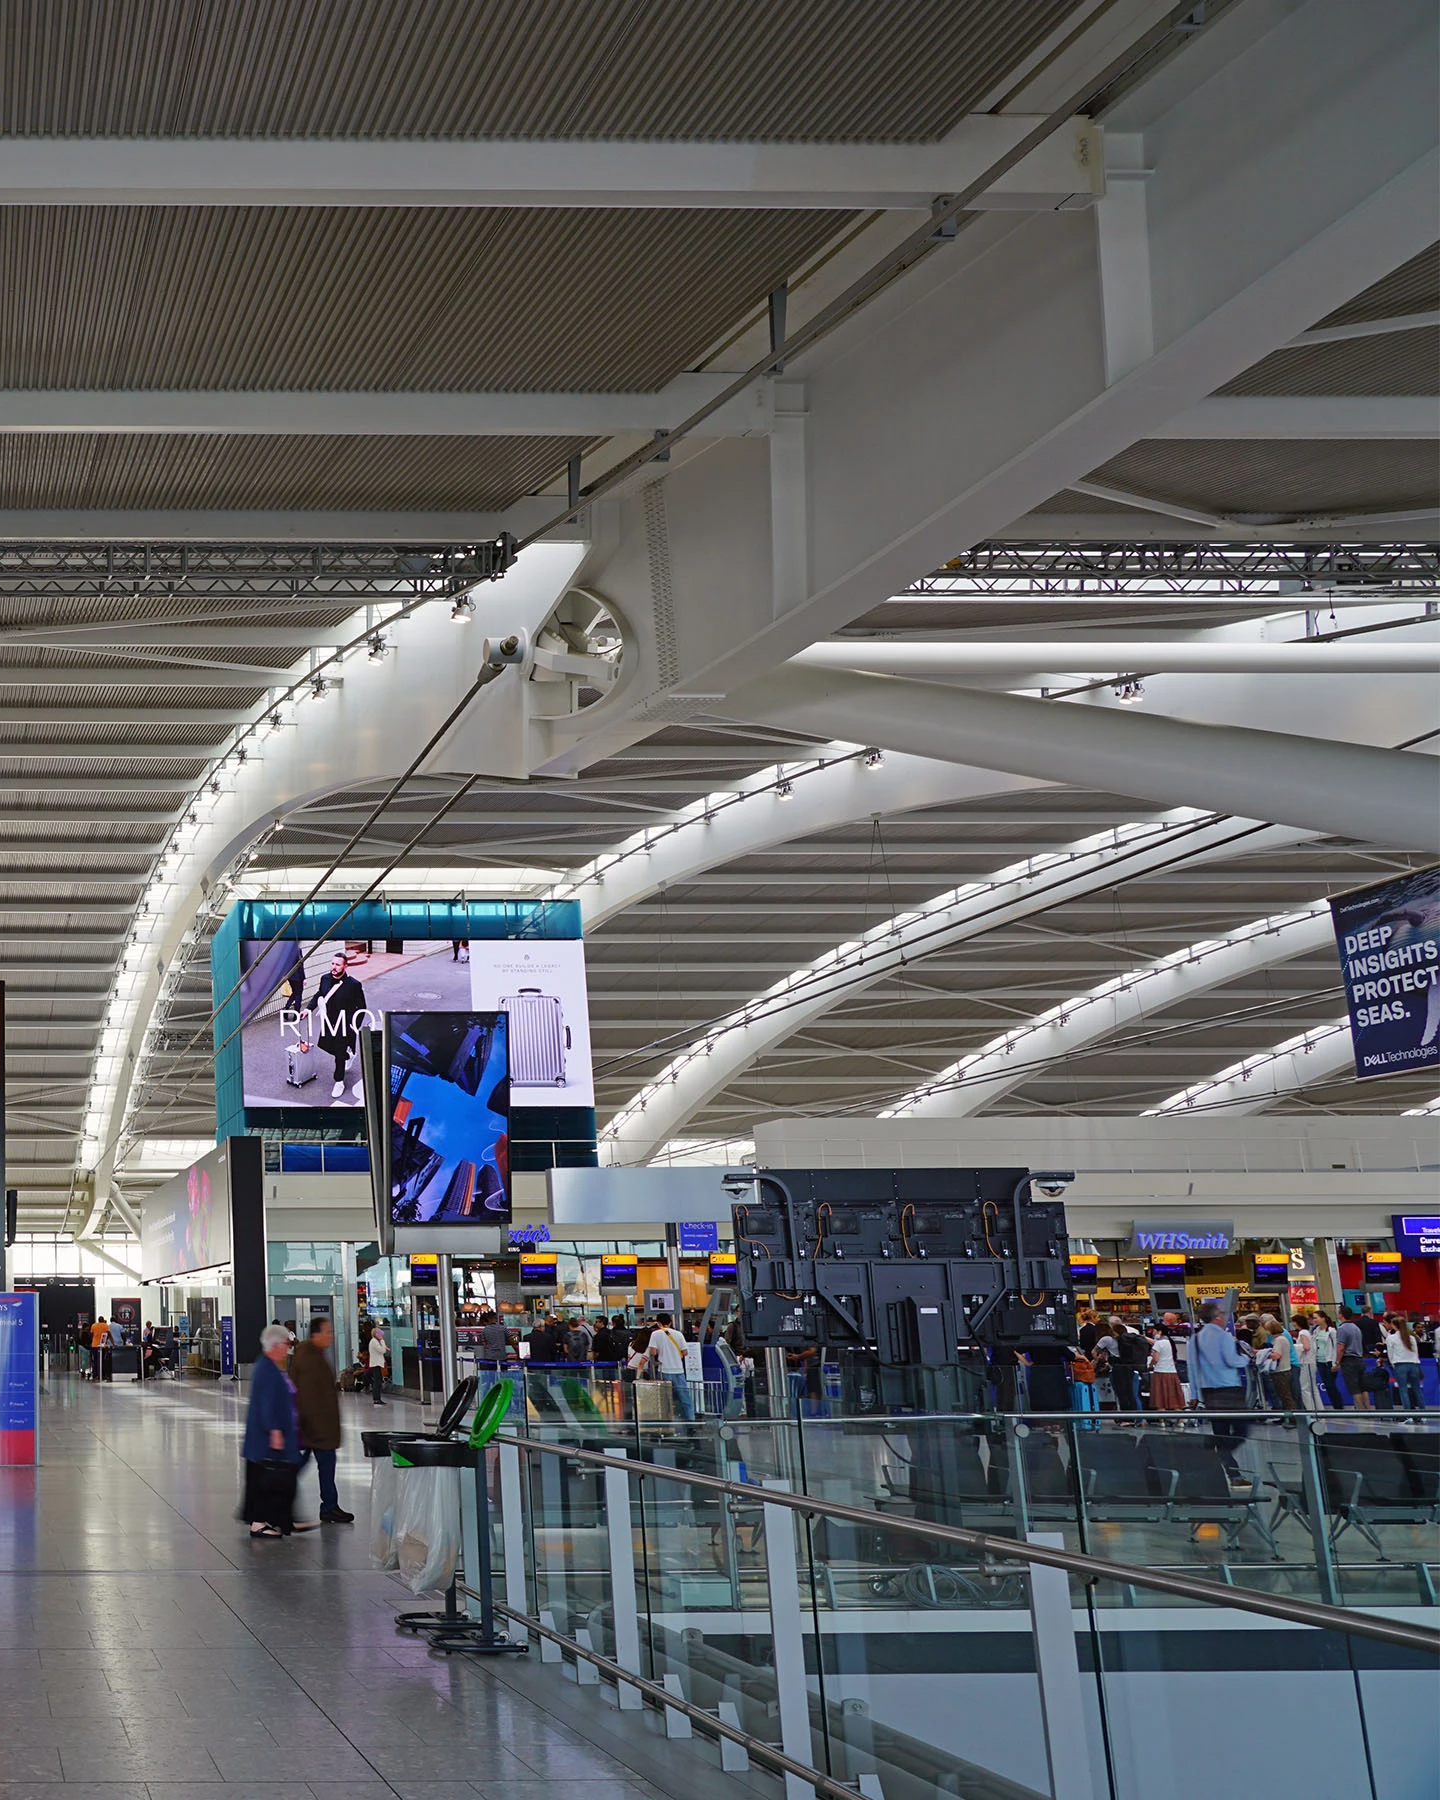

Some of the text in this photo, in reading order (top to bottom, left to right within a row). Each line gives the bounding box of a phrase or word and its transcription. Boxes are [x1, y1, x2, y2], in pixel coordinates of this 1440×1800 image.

[1345, 926, 1392, 954] DEEP
[1349, 940, 1438, 979] INSIGHTS
[1352, 966, 1439, 1003] PROTECT
[1356, 1000, 1411, 1027] SEAS.
[1136, 1232, 1229, 1250] WHSmith
